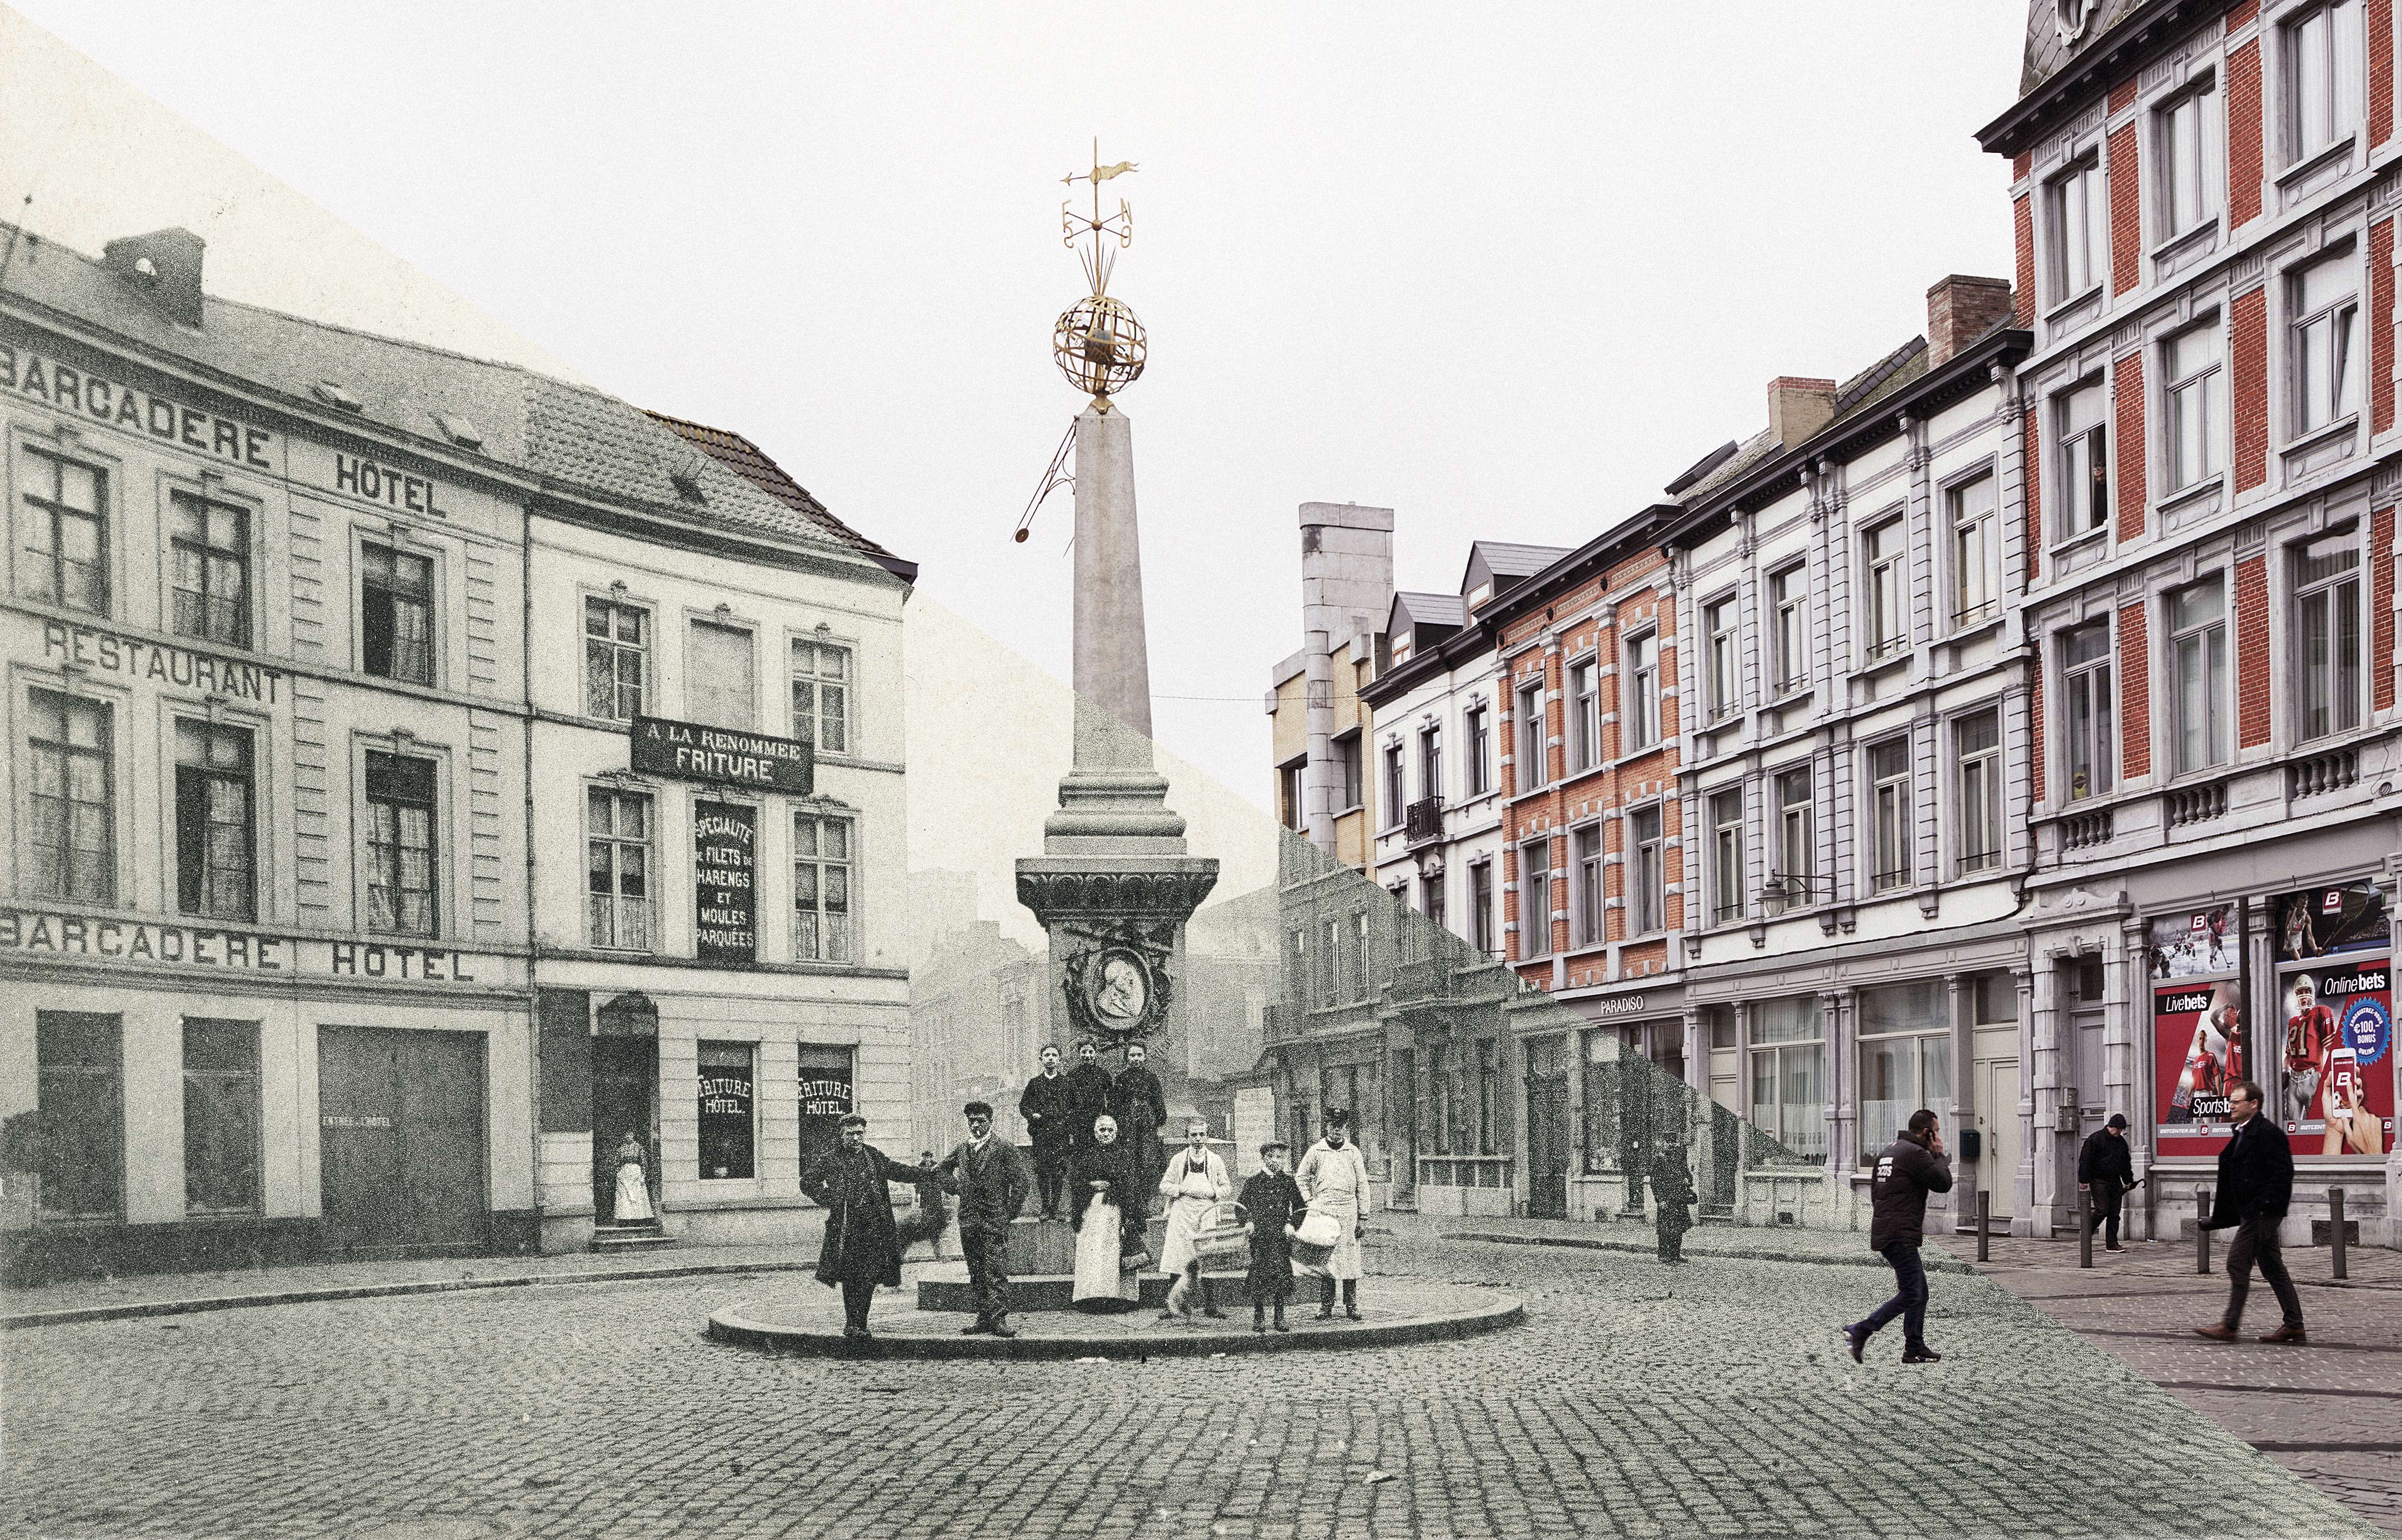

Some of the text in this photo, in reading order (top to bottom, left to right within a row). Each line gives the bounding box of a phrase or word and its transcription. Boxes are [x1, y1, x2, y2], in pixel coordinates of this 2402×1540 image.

[1121, 198, 1132, 225] N
[44, 621, 281, 704] RESTAURANT
[669, 726, 692, 744] LA
[677, 747, 773, 782] FRITURE
[706, 846, 740, 866] FILETS
[696, 868, 749, 887] HARENGS
[717, 892, 731, 903] ET
[2325, 892, 2339, 905] B
[702, 907, 746, 924] MOULES
[2193, 916, 2205, 928] B
[1601, 995, 1643, 1014] PARADISO
[2357, 1034, 2376, 1044] BONUS
[2358, 1046, 2375, 1055] ONLINE
[697, 1075, 751, 1097] FRITURE
[798, 1077, 851, 1100] FRITURE
